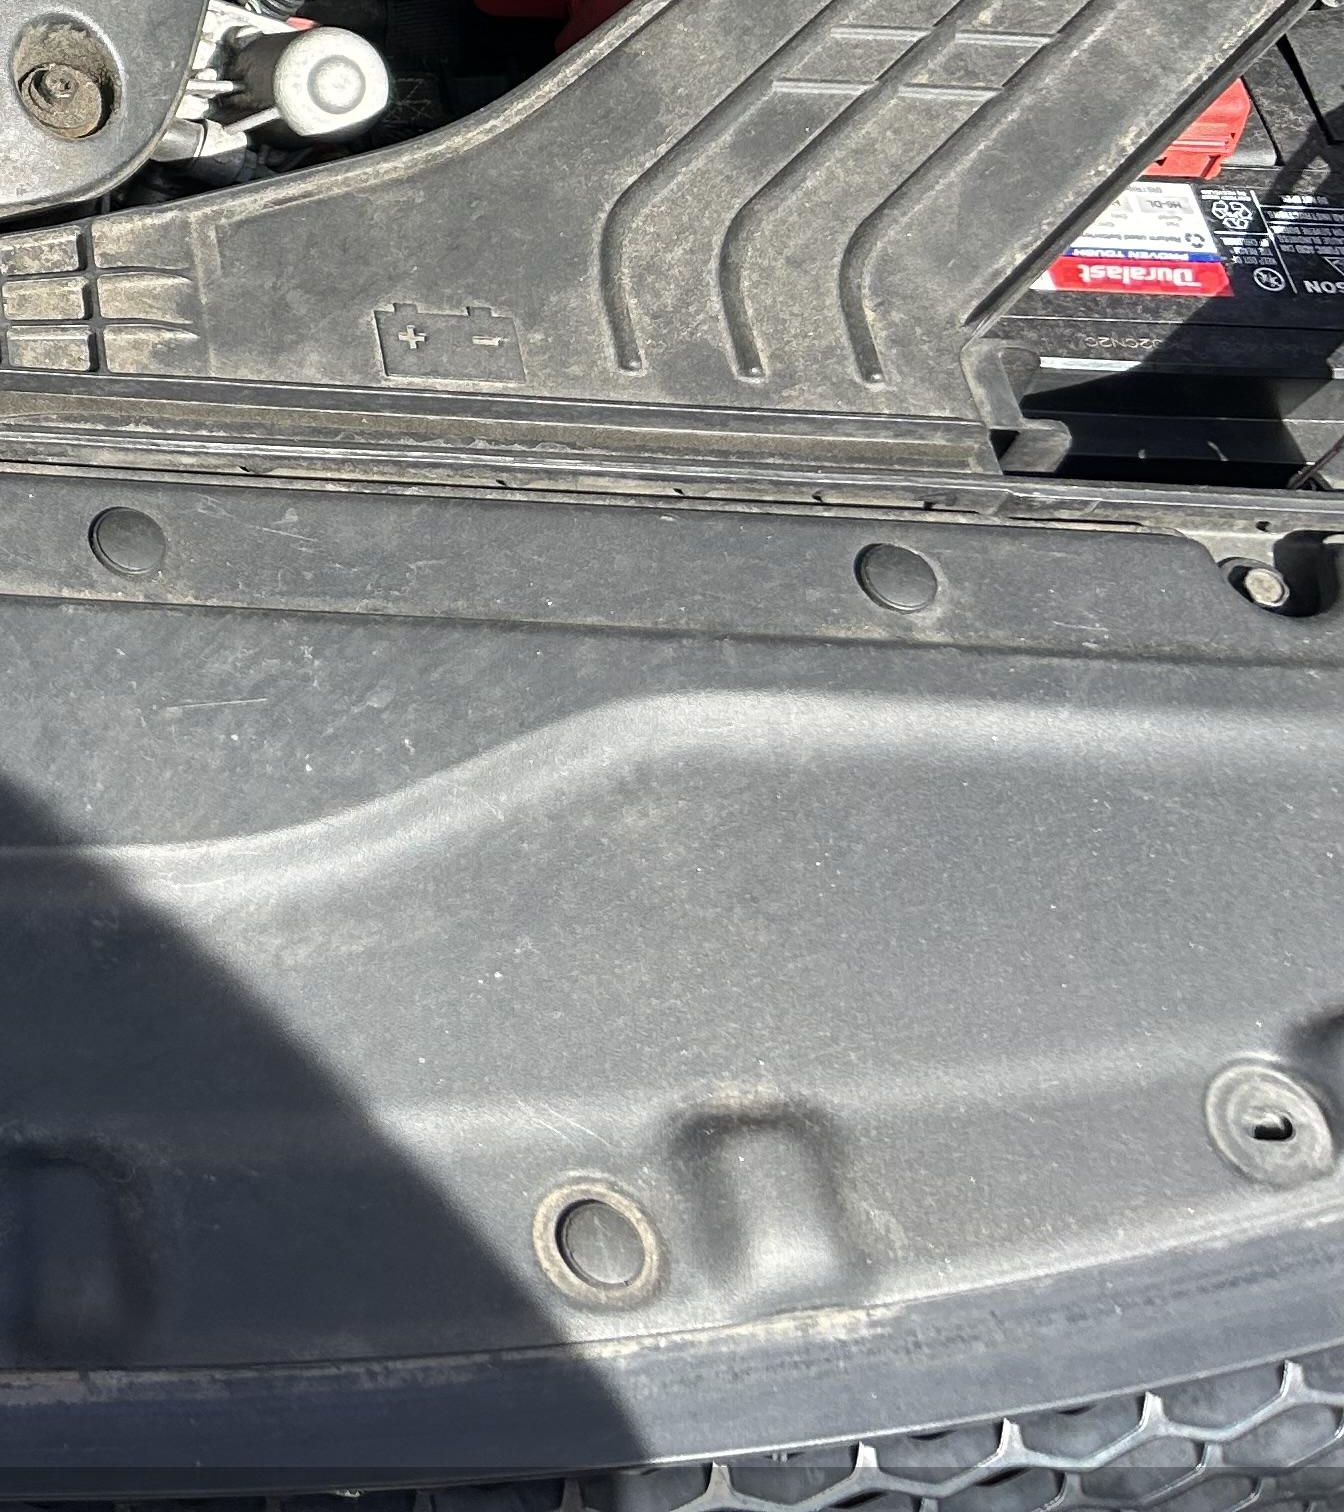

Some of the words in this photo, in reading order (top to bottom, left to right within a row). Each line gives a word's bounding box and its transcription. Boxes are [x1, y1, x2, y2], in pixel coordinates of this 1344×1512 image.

[1072, 248, 1126, 259] TOUGH
[1127, 250, 1190, 262] PROVEN
[1078, 263, 1203, 288] Duralast
